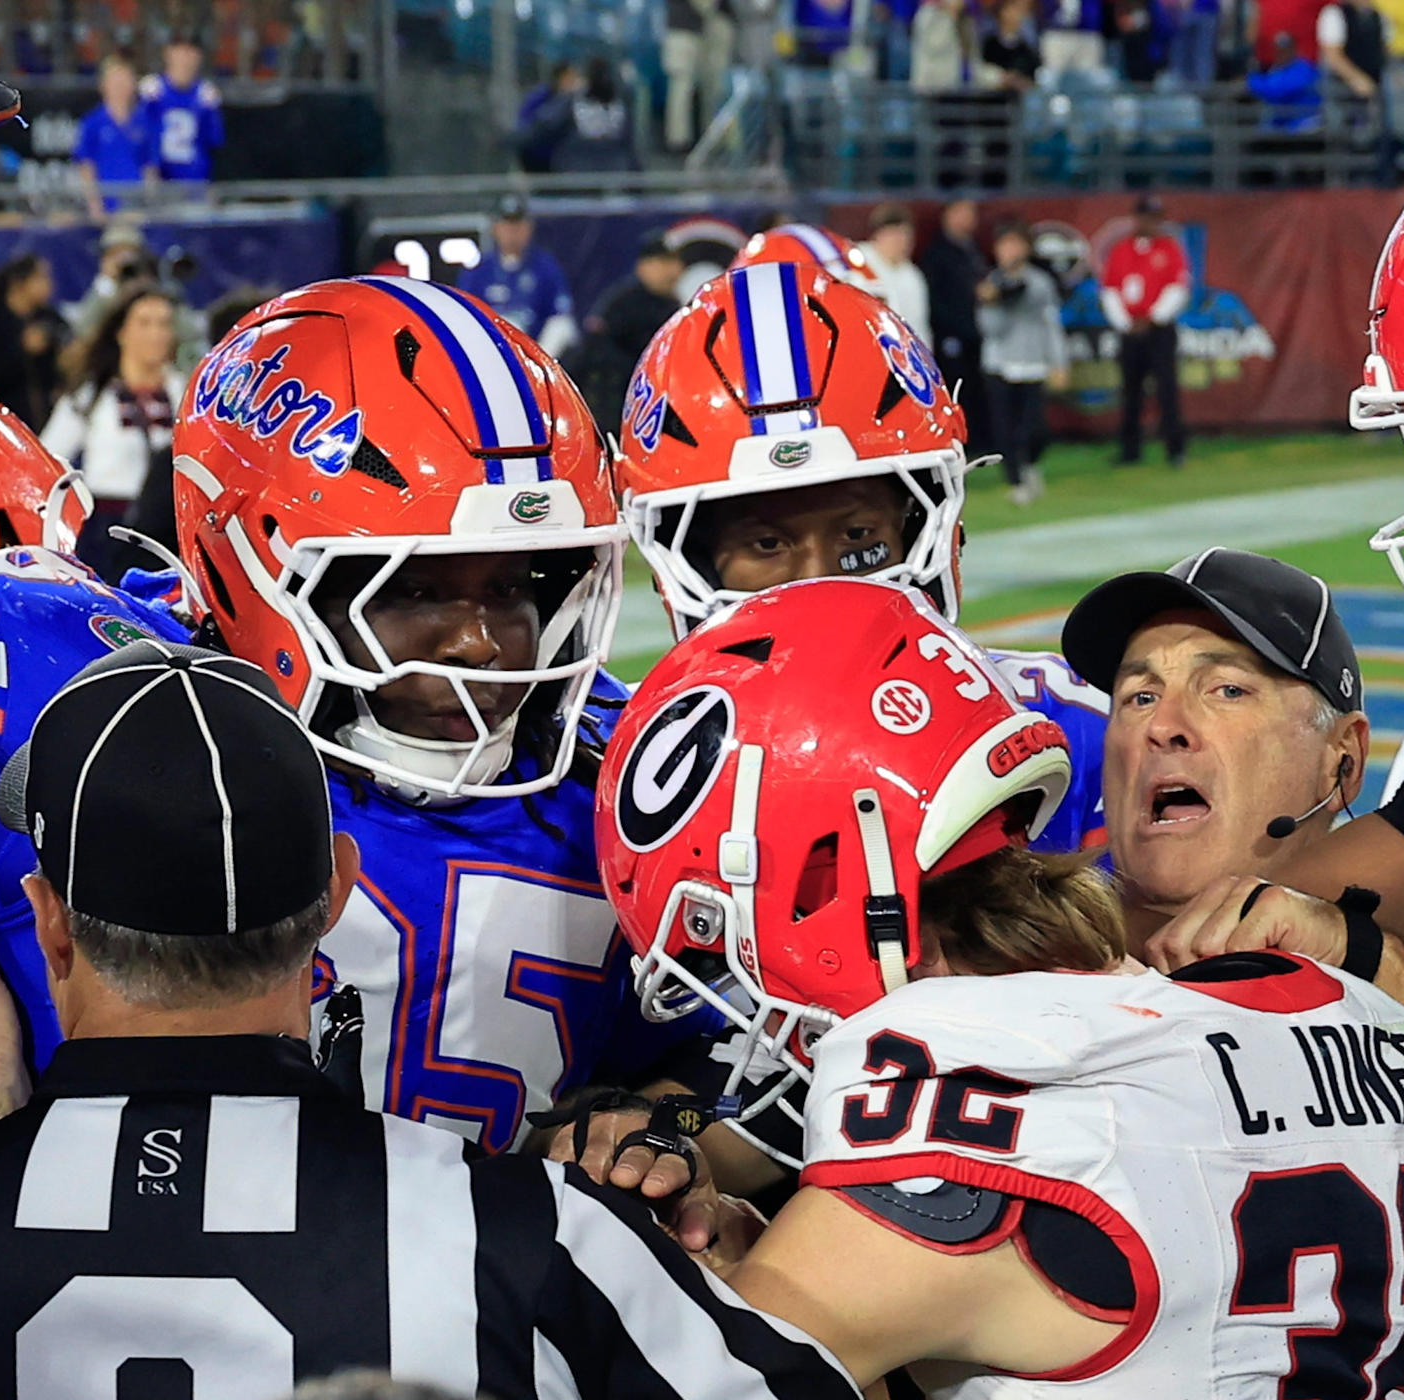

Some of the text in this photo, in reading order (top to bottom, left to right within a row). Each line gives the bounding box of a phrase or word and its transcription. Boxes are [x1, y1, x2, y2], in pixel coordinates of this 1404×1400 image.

[195, 327, 363, 477] Gators
[875, 683, 928, 732] SEC
[616, 687, 732, 850] G
[839, 1027, 1033, 1154] 32
[1205, 1031, 1287, 1136] C.
[137, 1181, 180, 1195] USA
